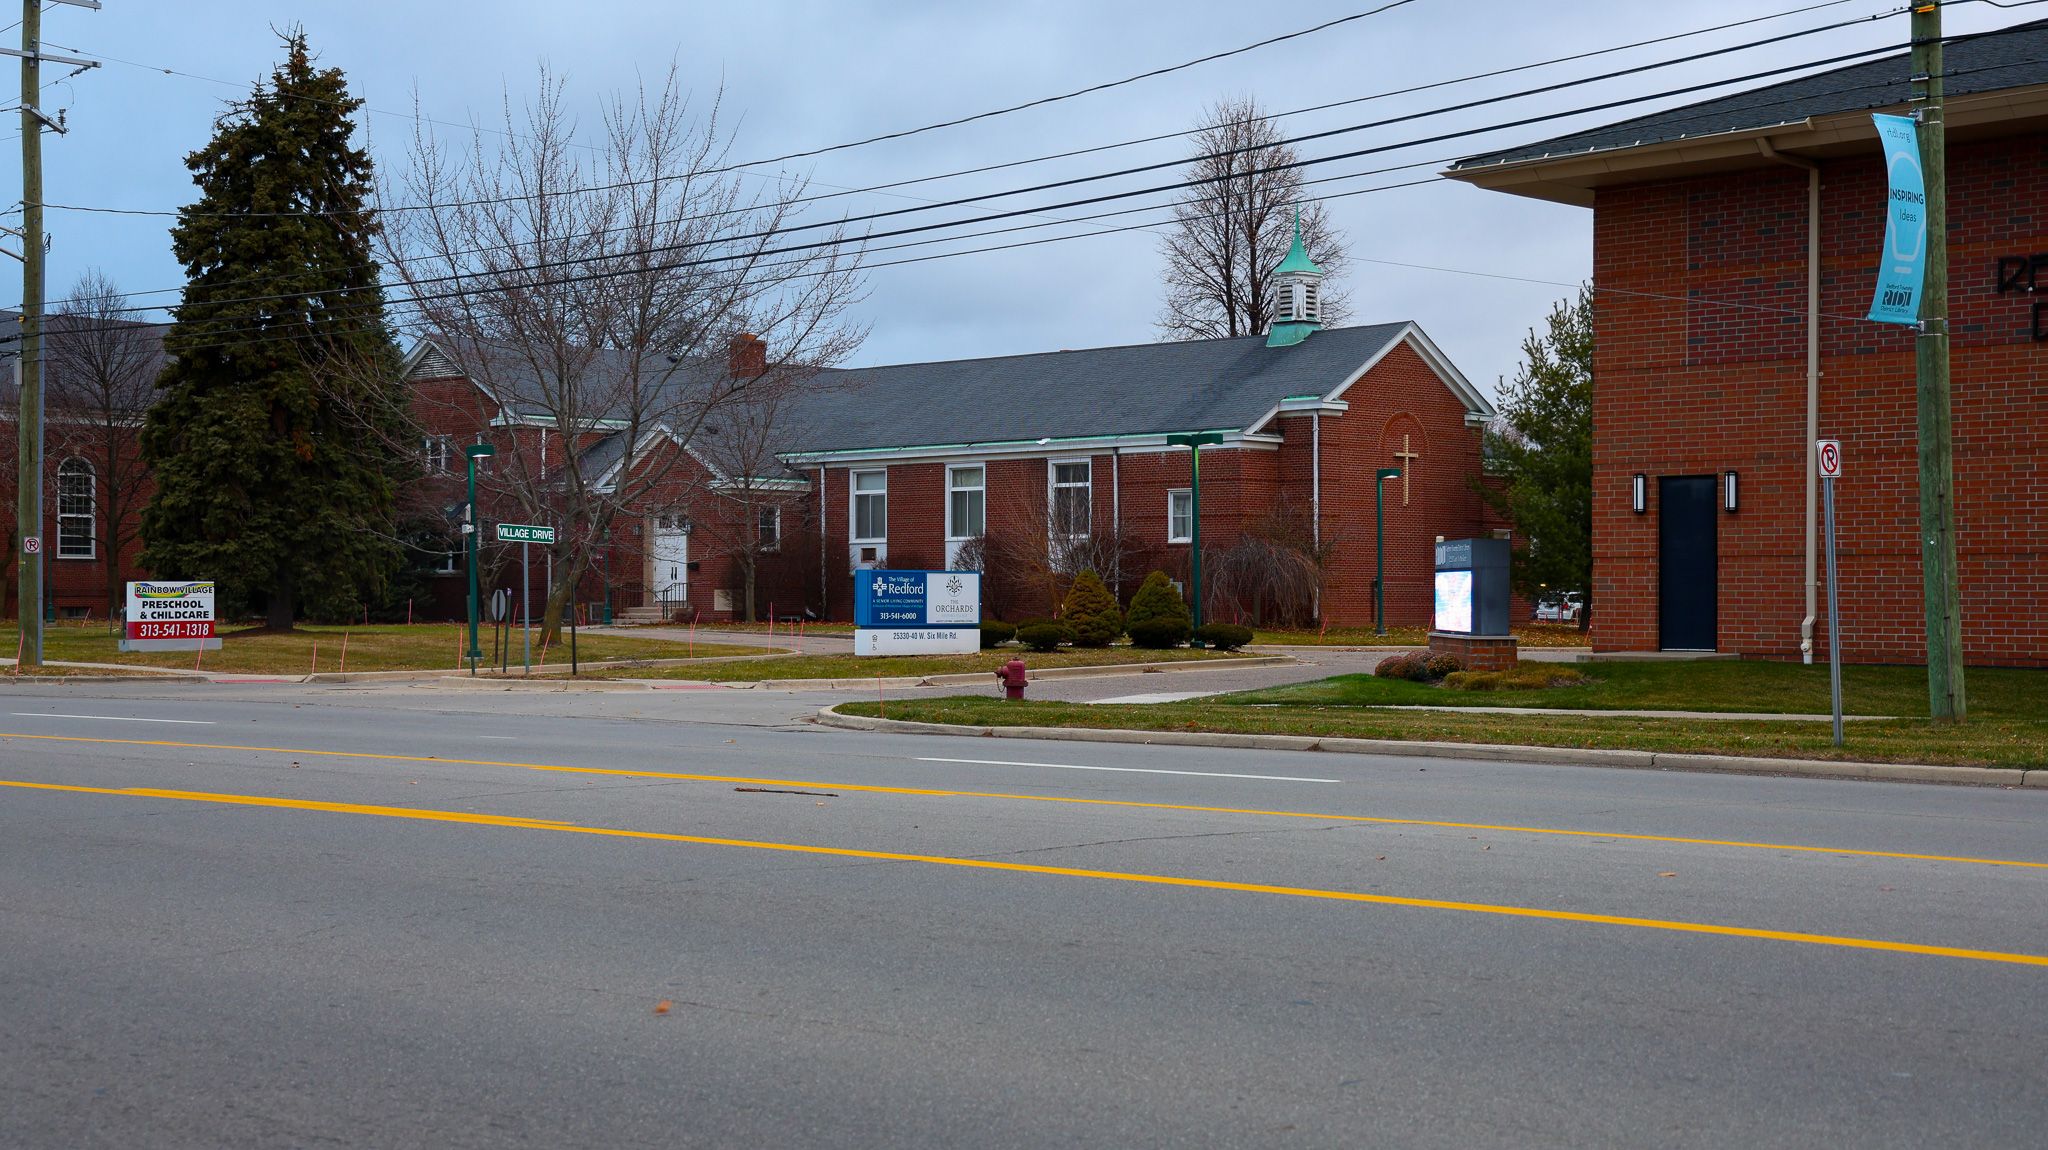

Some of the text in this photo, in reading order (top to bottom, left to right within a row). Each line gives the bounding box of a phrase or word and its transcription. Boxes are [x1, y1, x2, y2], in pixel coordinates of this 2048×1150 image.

[1890, 188, 1924, 205] INSPIRING
[1899, 208, 1917, 222] Ideas
[499, 527, 553, 540] VILLAGE DRIVE
[135, 586, 213, 594] RAINBOW VILLAGE
[888, 583, 924, 595] Redford
[142, 600, 204, 609] PRESCHOOL
[935, 604, 974, 613] ORCHARDS
[140, 611, 209, 619] & CHILDCARE
[880, 612, 917, 620] 313-541-6000
[140, 623, 209, 637] 313-541-1318
[893, 632, 958, 640] 25330-40 W. Six Mile Rd.
